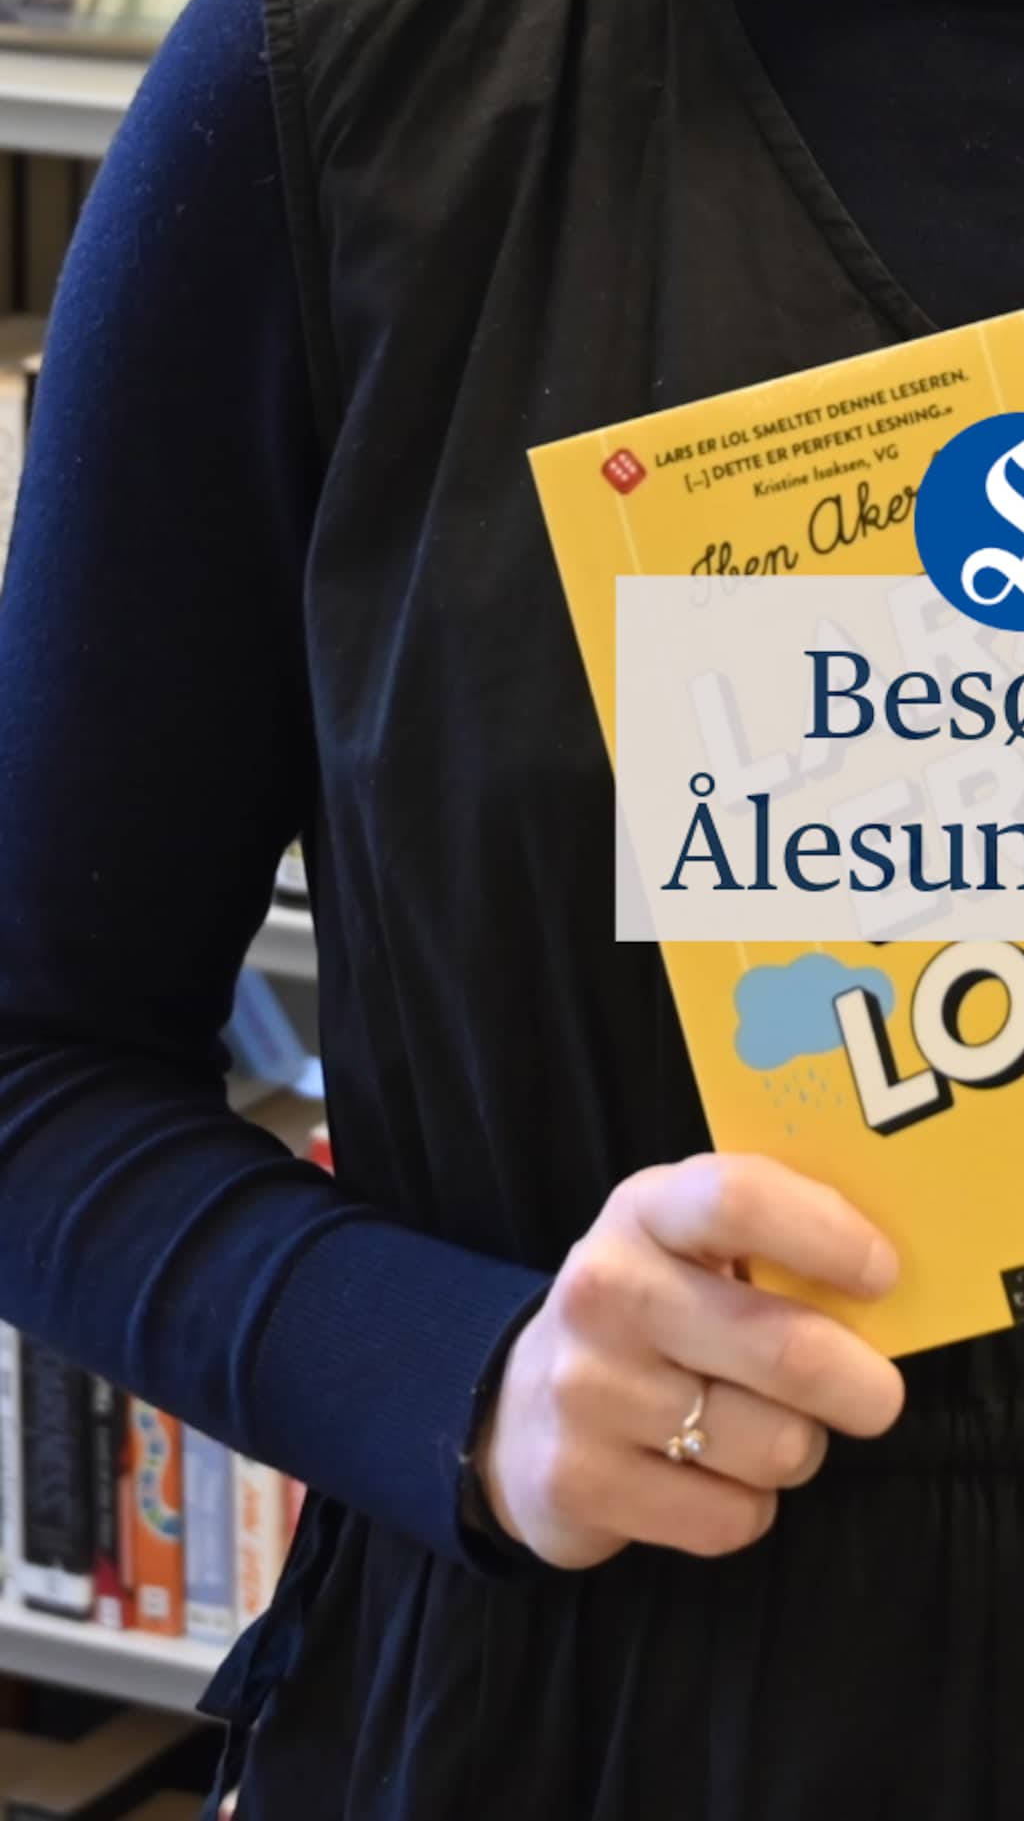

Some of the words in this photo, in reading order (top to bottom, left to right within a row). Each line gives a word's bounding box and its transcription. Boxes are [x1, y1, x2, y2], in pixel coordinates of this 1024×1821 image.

[655, 442, 694, 469] LARS
[697, 437, 718, 455] ER
[721, 431, 751, 452] LOL
[752, 409, 823, 442] SMELTET
[826, 391, 889, 421] DENNE
[712, 454, 764, 482] DETTE
[767, 447, 790, 465] ER
[792, 425, 864, 458] PERFEKT
[753, 470, 809, 499] Kristine
[873, 443, 900, 464] VG
[807, 480, 920, 556] Aker
